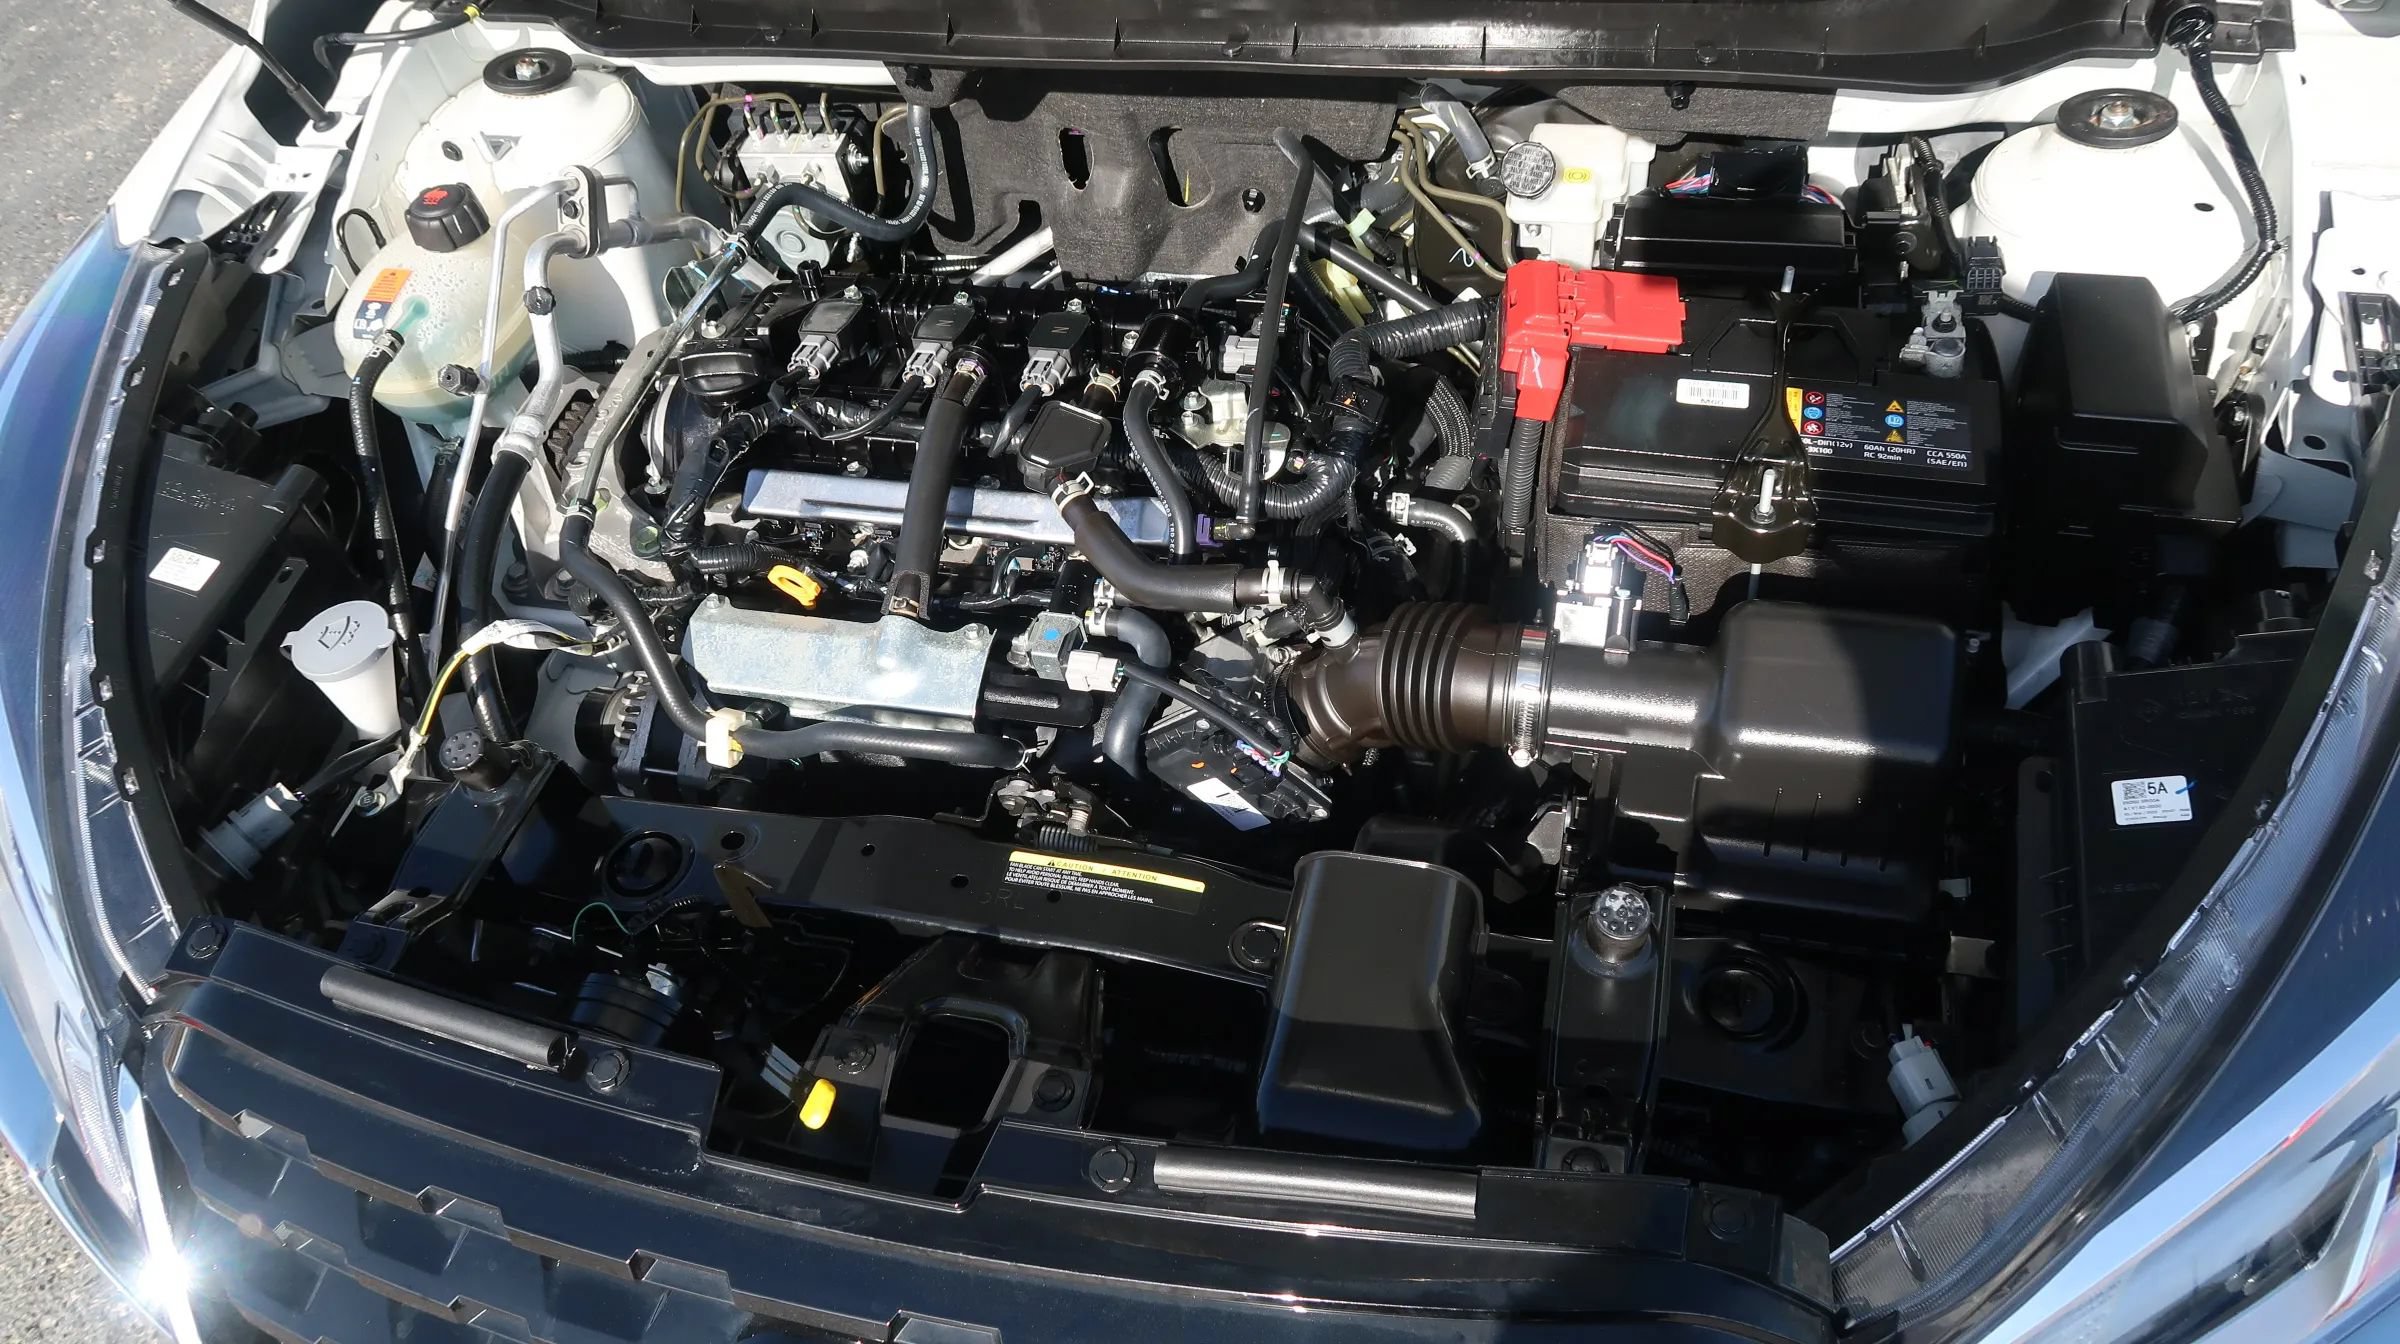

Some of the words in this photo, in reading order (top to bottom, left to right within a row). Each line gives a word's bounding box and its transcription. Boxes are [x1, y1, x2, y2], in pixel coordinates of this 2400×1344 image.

[1864, 444, 1885, 452] 60Ah
[1888, 446, 1916, 455] (20HR)
[1927, 450, 1944, 458] CCA
[1945, 451, 1967, 460] 550A
[1877, 453, 1902, 461] 92min
[2147, 781, 2168, 795] 5A
[1057, 860, 1094, 872] CAUTION
[1112, 869, 1157, 881] ATTENTION
[1012, 872, 1043, 881] VENTILATEUR
[1043, 876, 1060, 884] RISQUE
[1089, 877, 1105, 885] HANDS
[1098, 889, 1127, 899] APPROCHER
[1136, 896, 1154, 904] MAINS.
